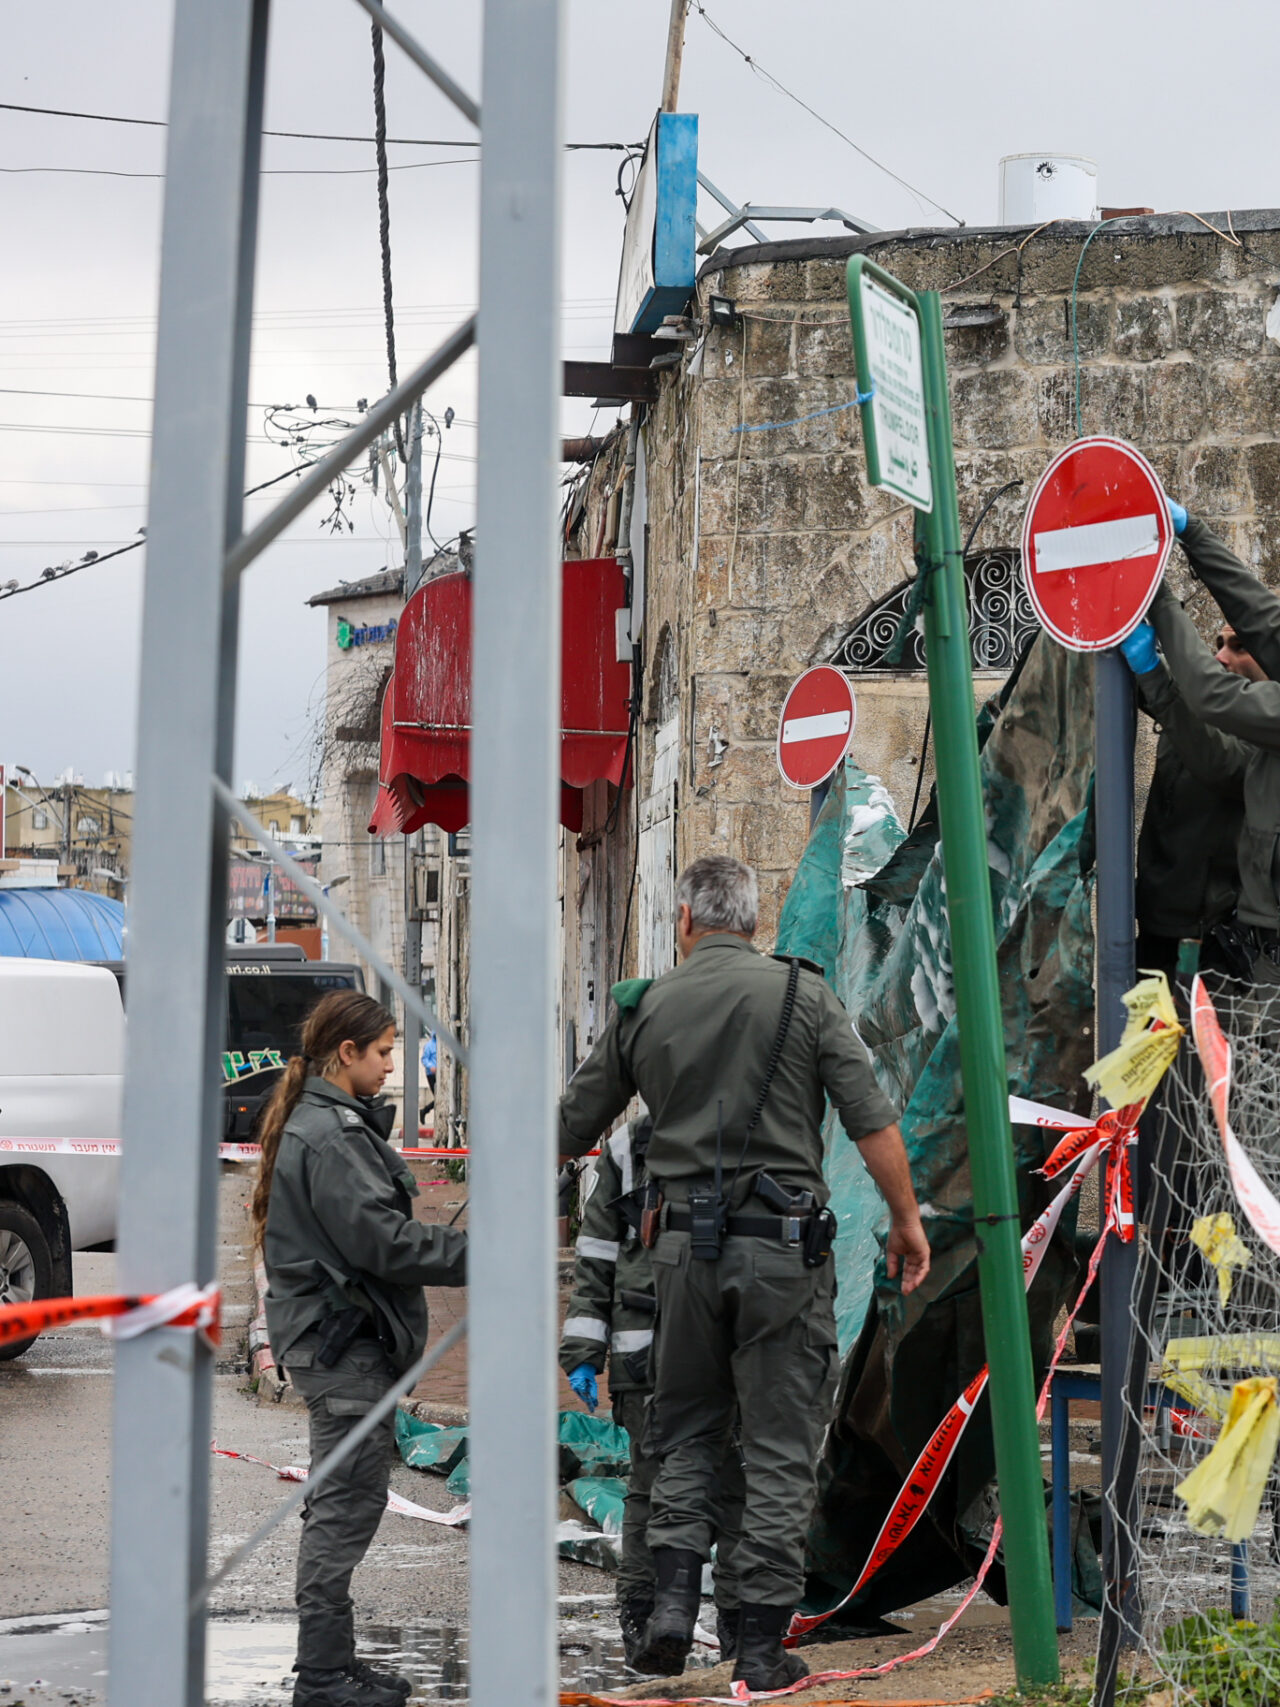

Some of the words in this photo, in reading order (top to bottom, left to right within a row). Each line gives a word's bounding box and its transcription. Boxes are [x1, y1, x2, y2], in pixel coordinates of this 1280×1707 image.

[17, 1143, 56, 1152] משטרת
[72, 1143, 99, 1152] מעבר
[101, 1143, 116, 1154] אין
[888, 1502, 919, 1543] ישראל
